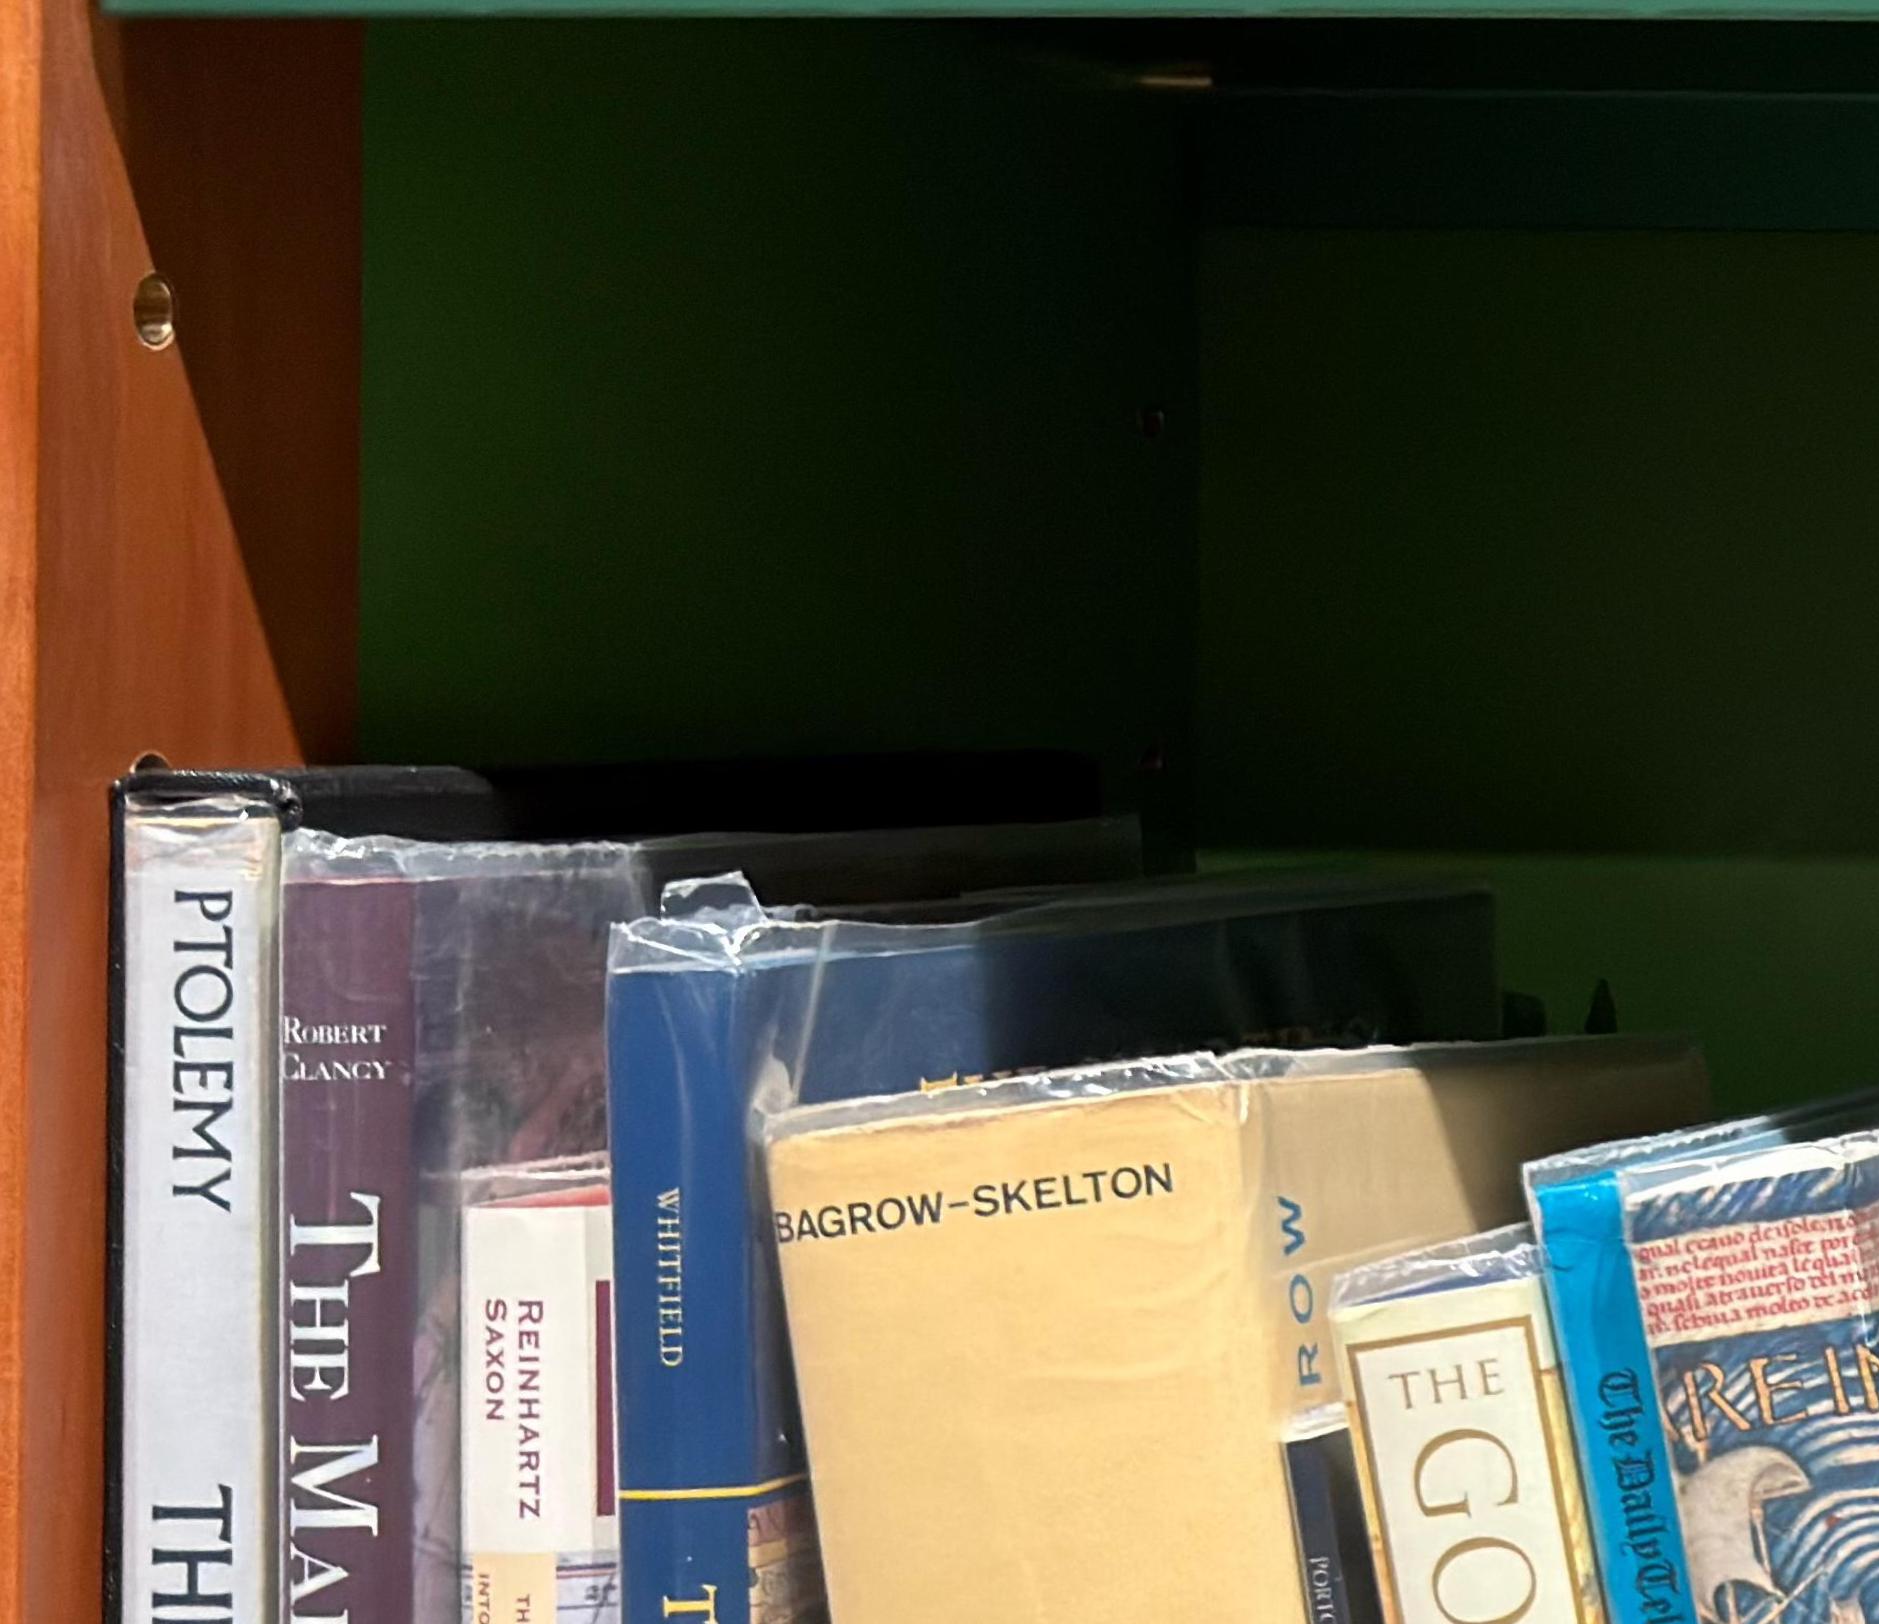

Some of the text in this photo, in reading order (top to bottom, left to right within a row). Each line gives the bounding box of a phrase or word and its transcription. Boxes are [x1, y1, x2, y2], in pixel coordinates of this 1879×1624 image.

[173, 891, 232, 1213] PTOLEMY
[282, 1017, 386, 1044] ROBERT
[282, 1054, 392, 1080] CLANCY
[290, 1192, 380, 1400] THE
[657, 1187, 682, 1366] WHITFIELD
[486, 1299, 503, 1422] SAXON
[518, 1301, 543, 1518] REINHARTZ
[1388, 1357, 1506, 1410] THE
[1598, 1369, 1639, 1448] The
[1618, 1456, 1668, 1568] Daily
